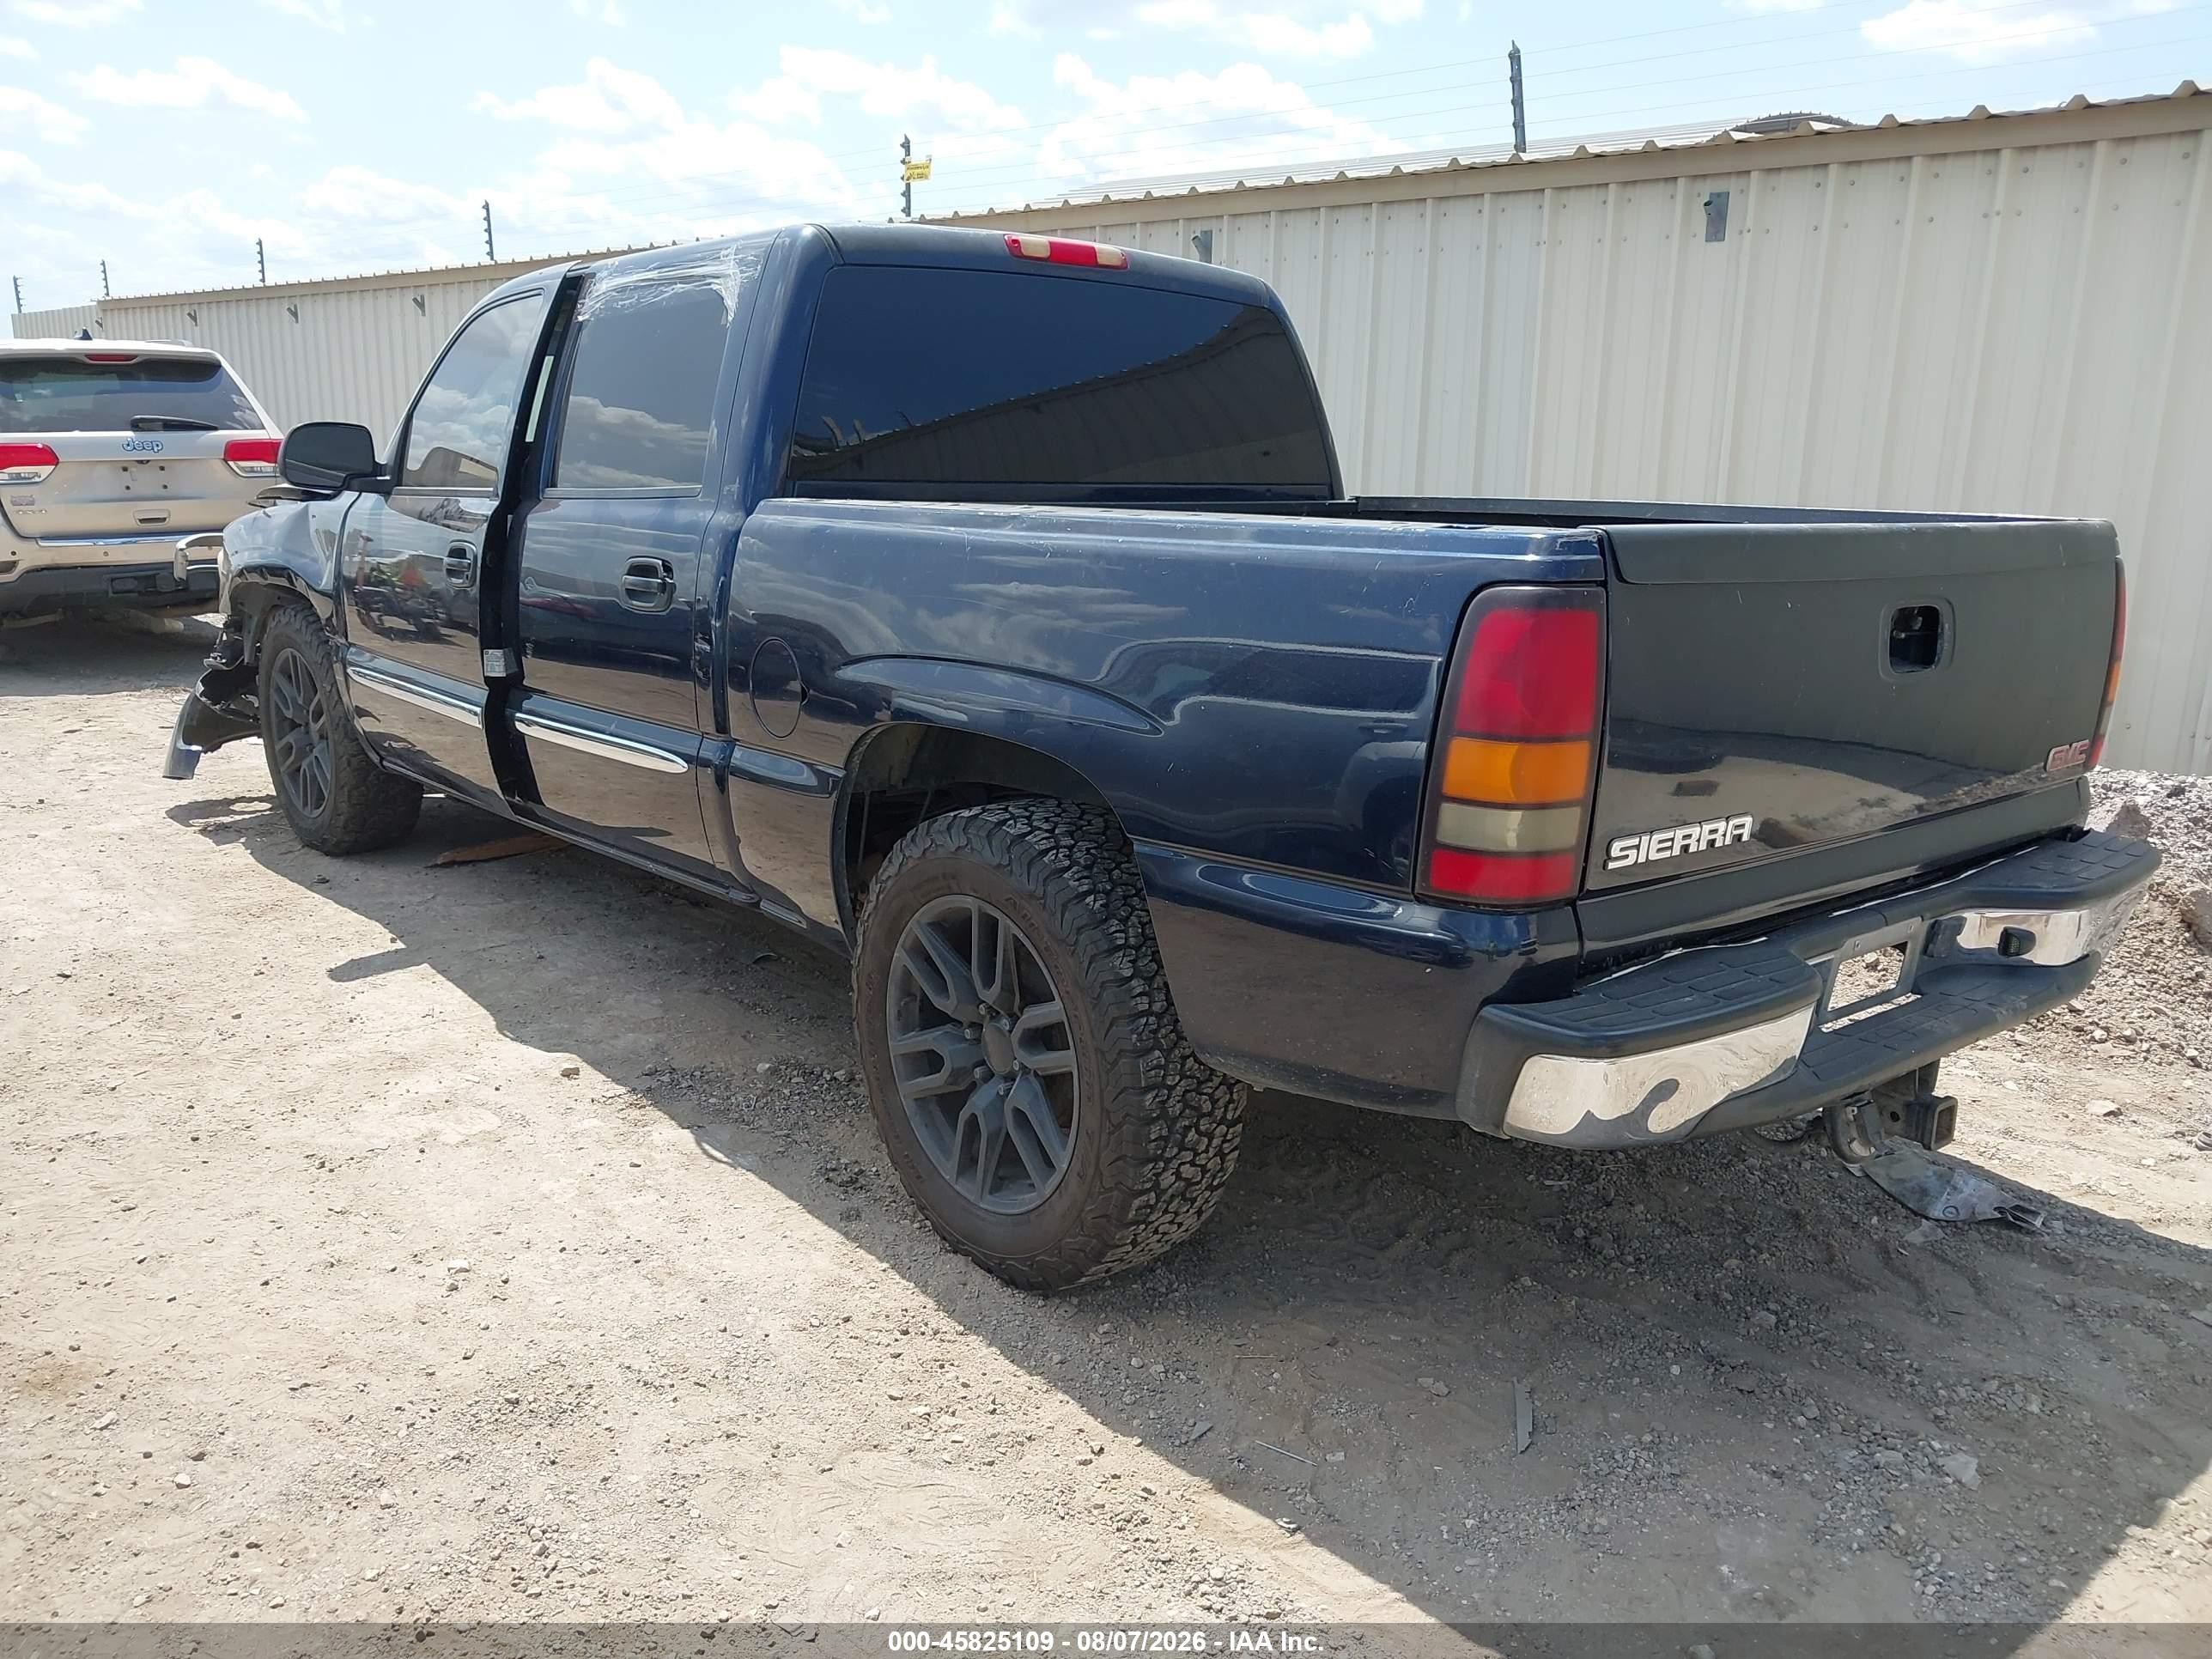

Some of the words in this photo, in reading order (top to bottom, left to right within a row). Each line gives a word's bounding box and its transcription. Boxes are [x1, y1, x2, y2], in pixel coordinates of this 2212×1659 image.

[122, 438, 164, 453] Jeep
[2045, 739, 2089, 771] GMC
[1605, 813, 1753, 870] SIERRA
